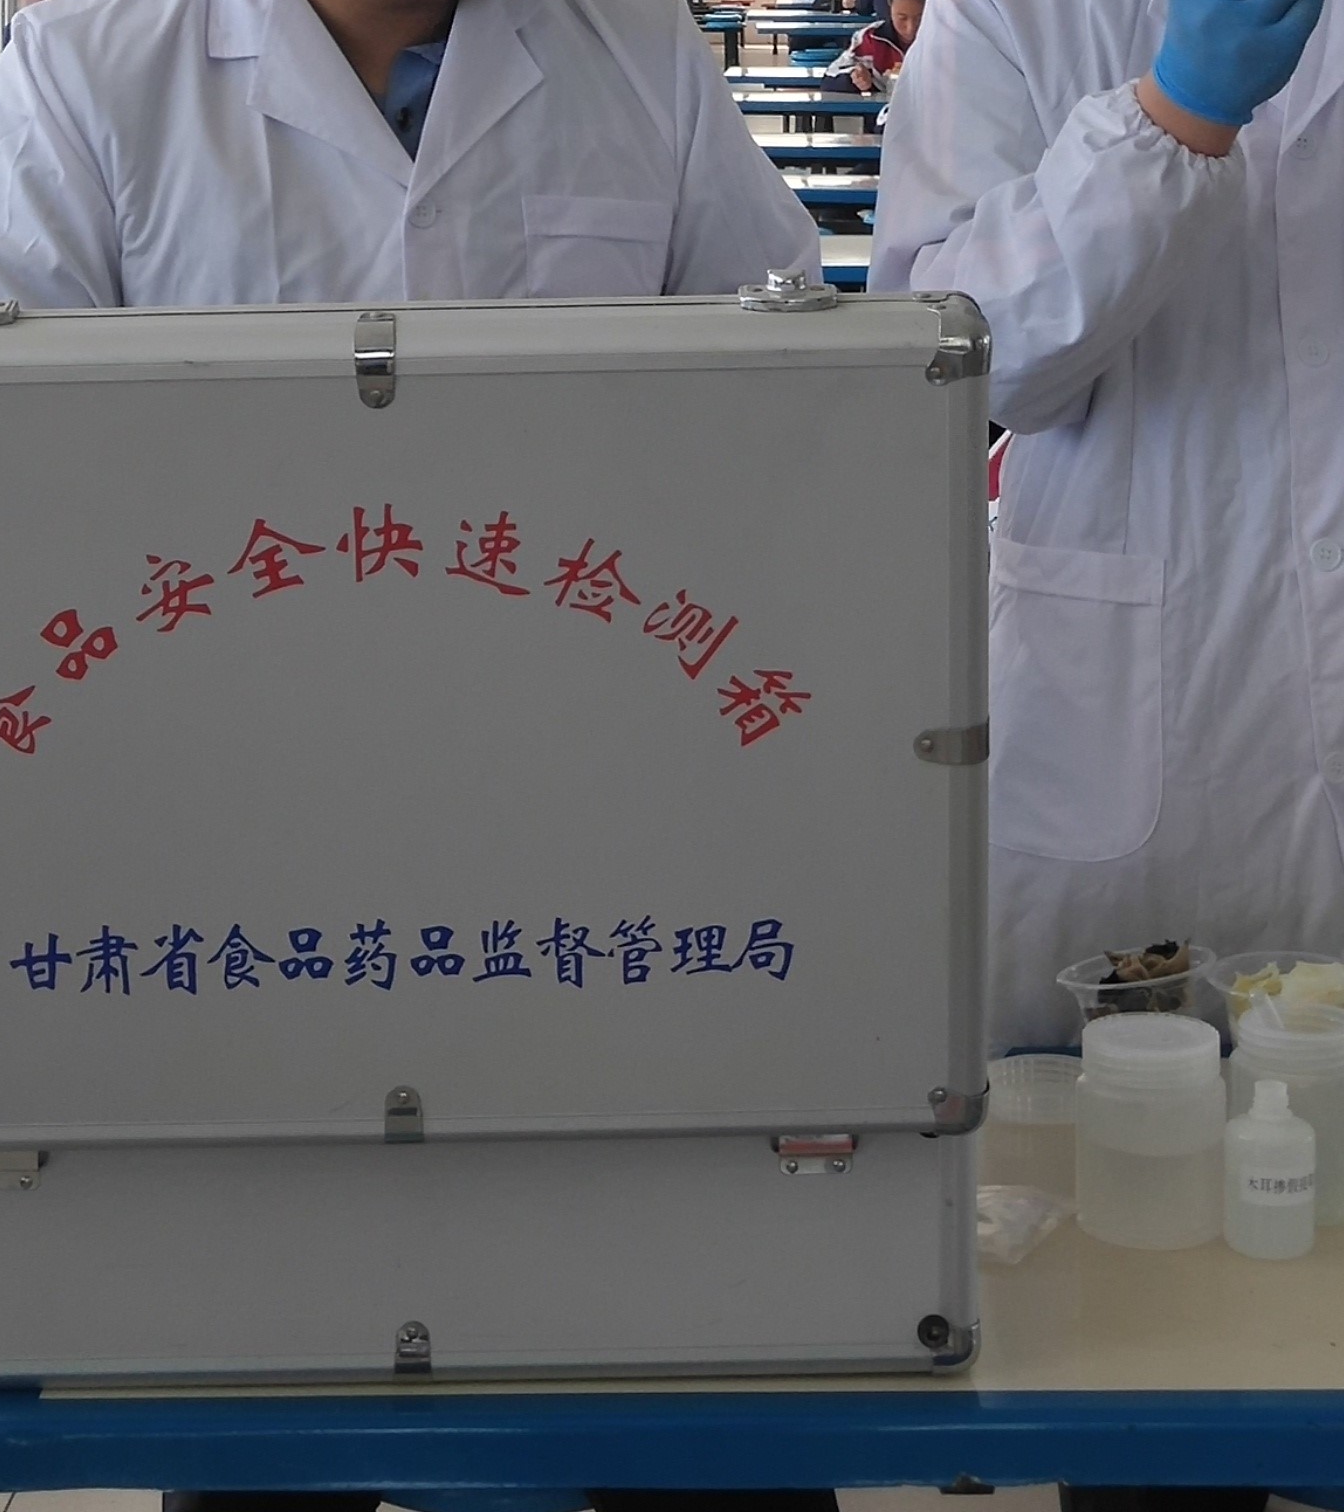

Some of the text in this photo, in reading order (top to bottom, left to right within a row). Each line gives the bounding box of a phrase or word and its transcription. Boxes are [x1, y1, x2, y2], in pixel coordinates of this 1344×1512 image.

[10, 915, 794, 995] 甘肃省食品药品监督管理局
